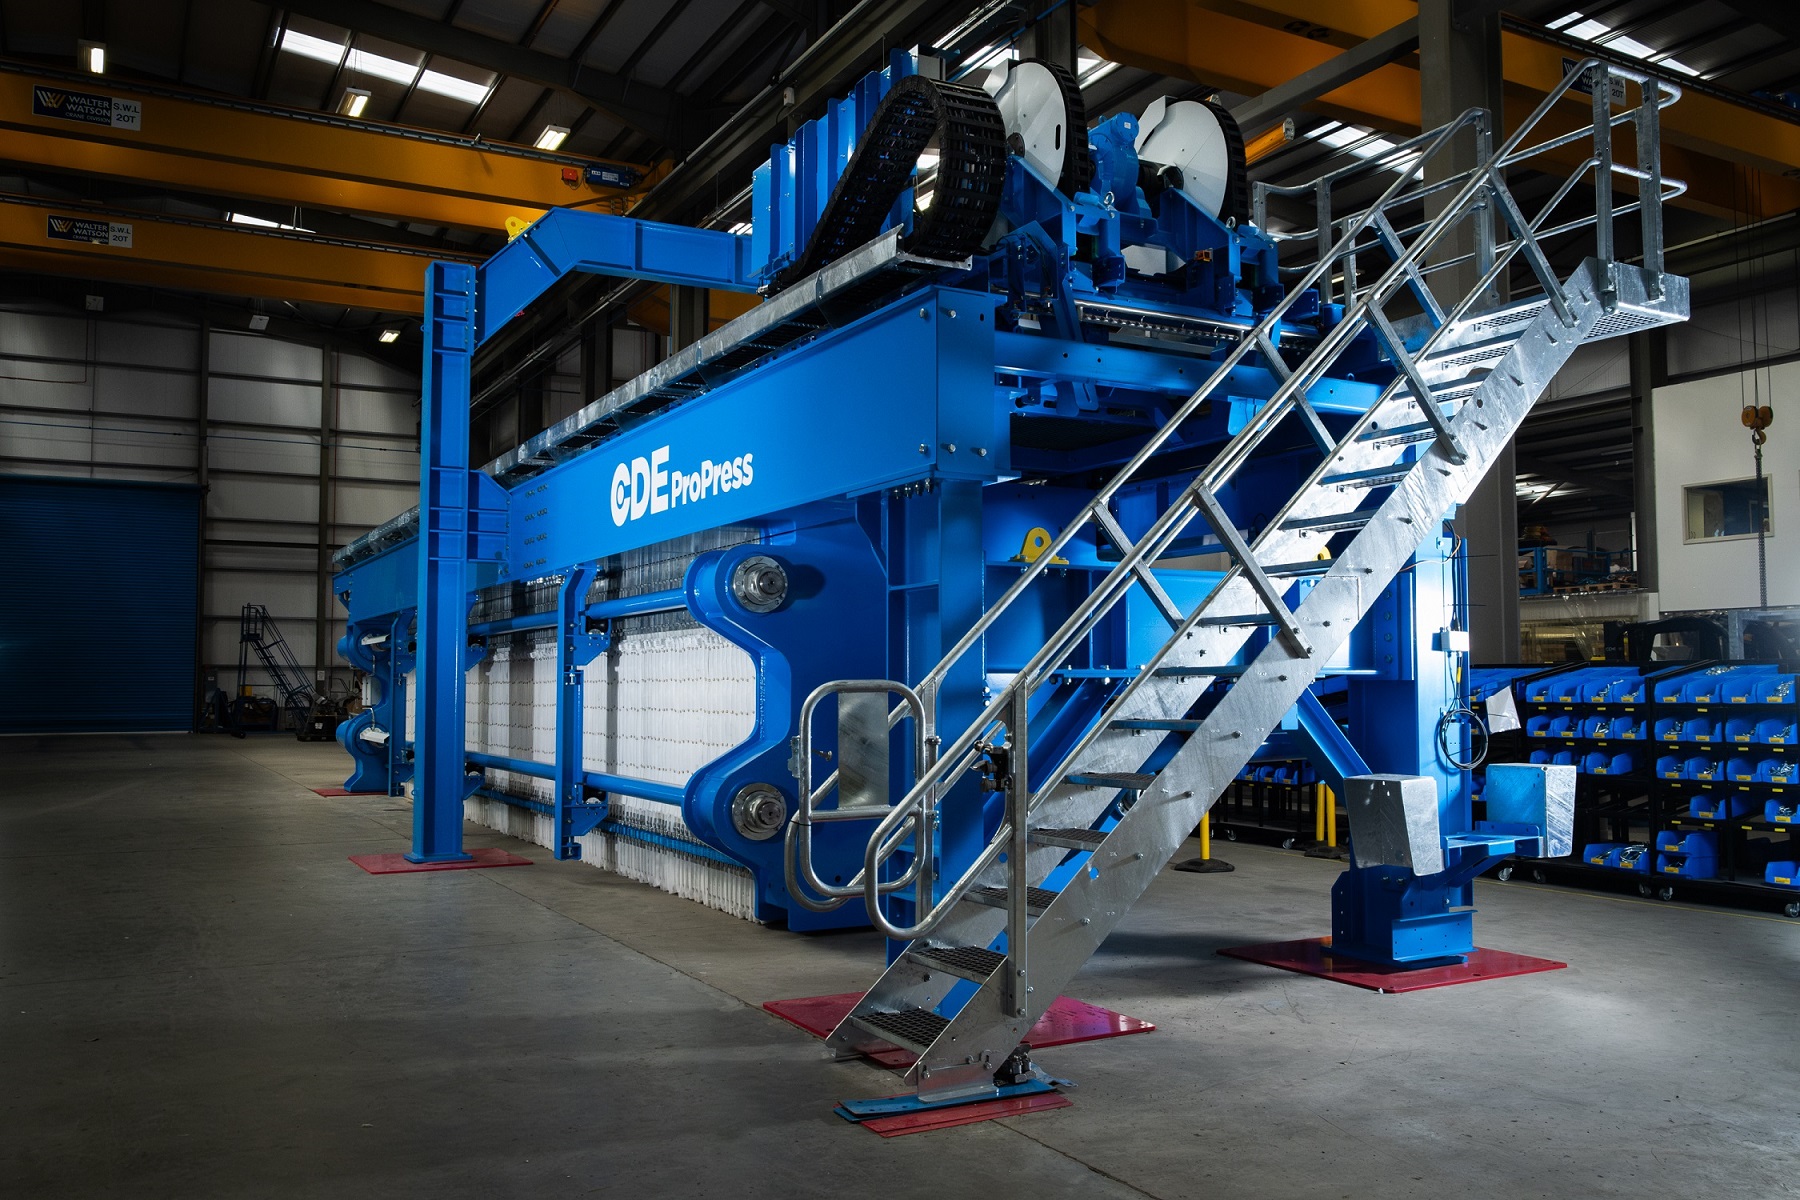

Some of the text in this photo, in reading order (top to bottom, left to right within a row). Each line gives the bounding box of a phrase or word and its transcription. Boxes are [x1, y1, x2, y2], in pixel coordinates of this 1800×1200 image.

[1611, 89, 1624, 98] 20T
[69, 95, 110, 109] WALTER
[66, 103, 111, 117] WATSON
[113, 102, 140, 114] S.W.L
[65, 112, 111, 123] CRANE DIVISION
[116, 113, 136, 123] 20T
[75, 221, 108, 232] WALTER
[73, 228, 109, 238] WATSON
[112, 234, 129, 242] 20T
[610, 444, 754, 527] CDE ProPress
